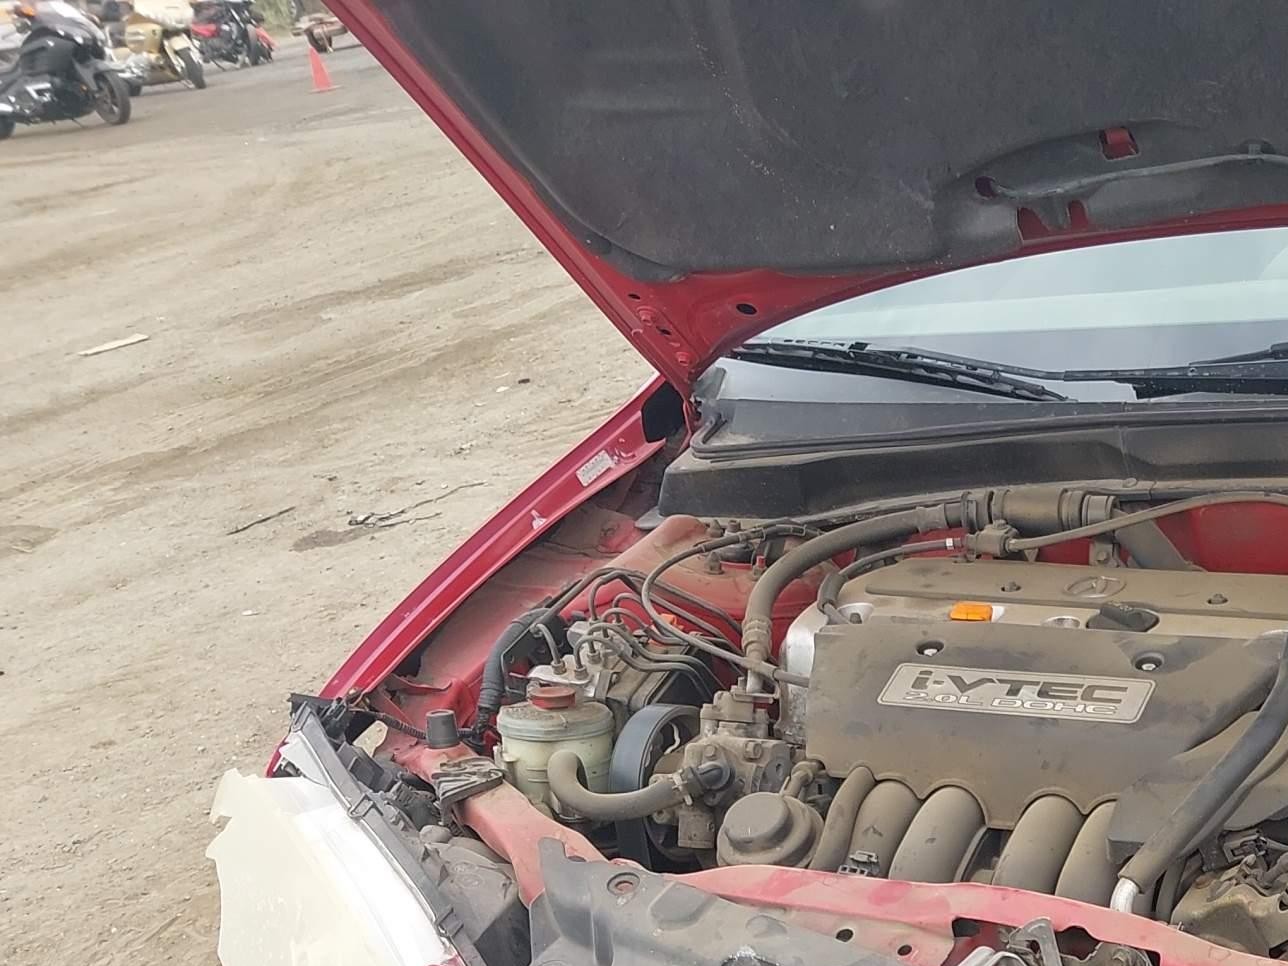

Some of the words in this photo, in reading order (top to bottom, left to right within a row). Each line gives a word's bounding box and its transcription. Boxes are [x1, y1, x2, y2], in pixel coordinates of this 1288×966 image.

[911, 670, 1128, 704] i-VTEC
[903, 691, 983, 706] 2.0L
[991, 697, 1118, 715] DOHC
